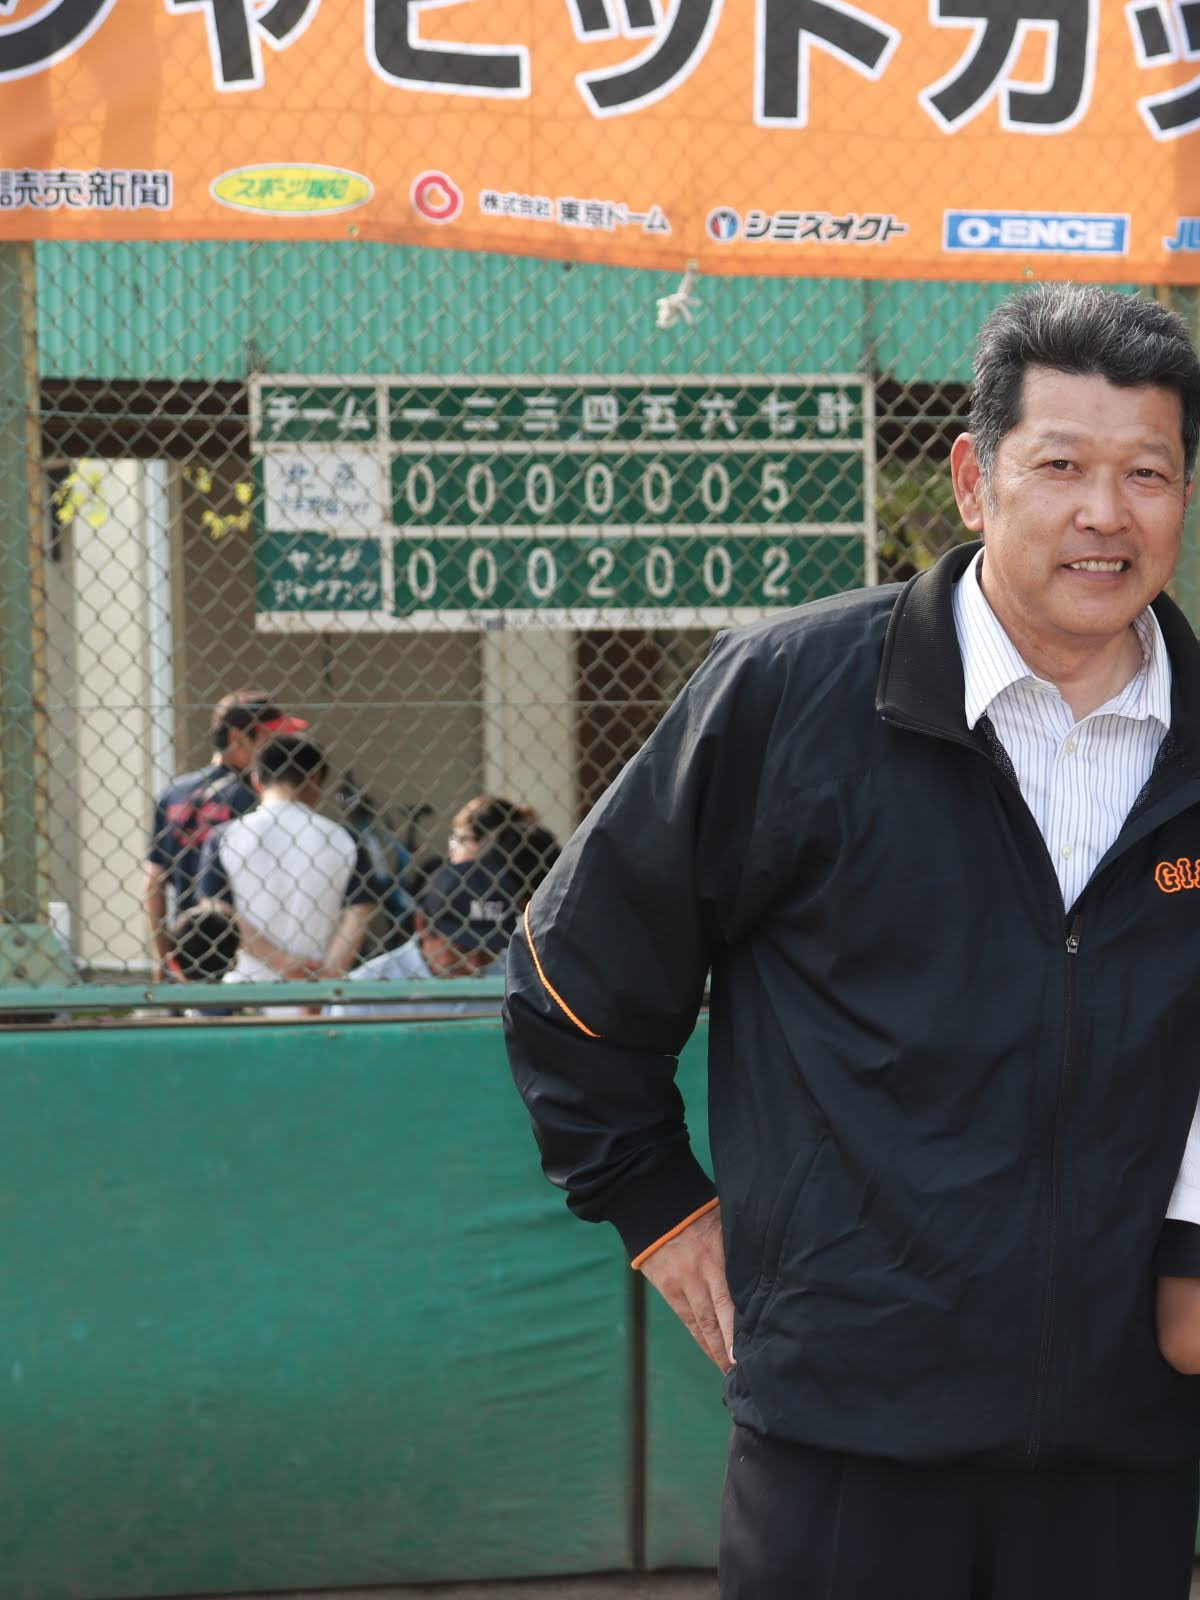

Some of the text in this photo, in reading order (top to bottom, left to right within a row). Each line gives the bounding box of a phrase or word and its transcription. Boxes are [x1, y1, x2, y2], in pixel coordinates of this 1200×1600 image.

[266, 395, 372, 432] チーム
[462, 396, 500, 432] 二
[524, 396, 560, 432] 三
[582, 394, 620, 432] 四
[640, 394, 679, 432] 五
[700, 392, 739, 434] 六
[761, 392, 800, 433] 七
[816, 391, 857, 433] 計
[406, 463, 435, 515] 0
[466, 463, 496, 515] 0
[525, 462, 556, 515] 0
[584, 462, 615, 514] 0
[643, 461, 673, 514] 0
[701, 462, 731, 514] 0
[761, 462, 790, 513] 5
[407, 546, 791, 600] 0 0 0 2 0 0 2
